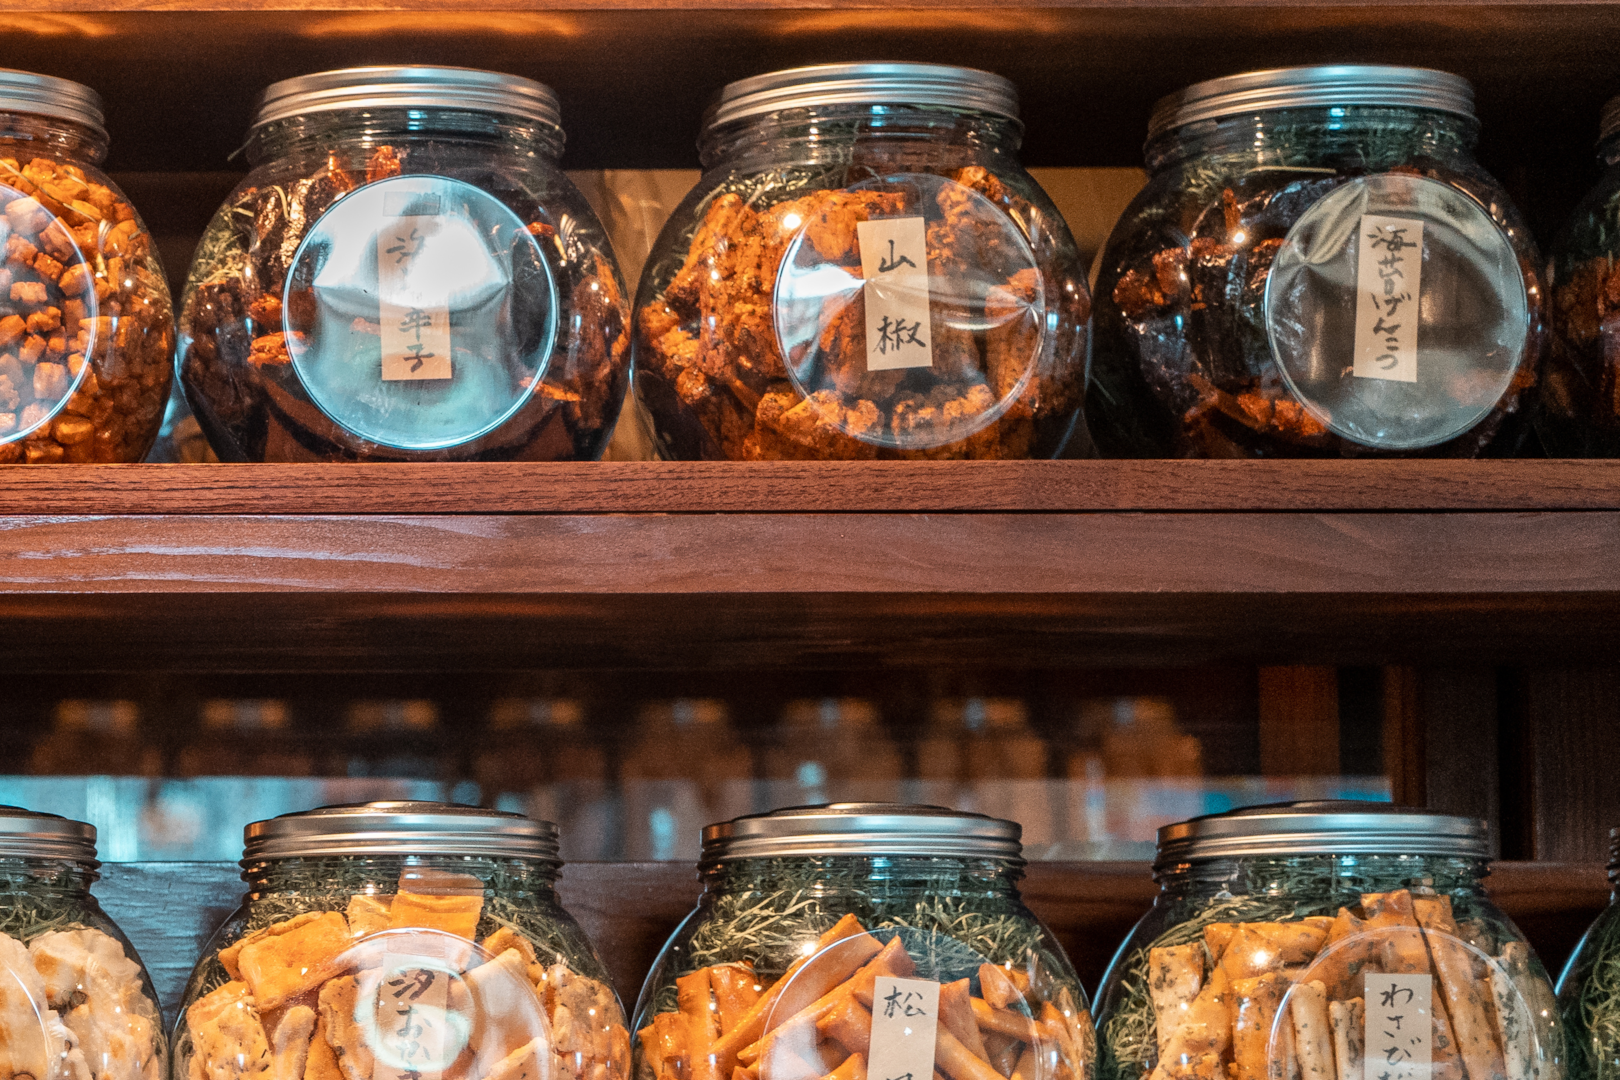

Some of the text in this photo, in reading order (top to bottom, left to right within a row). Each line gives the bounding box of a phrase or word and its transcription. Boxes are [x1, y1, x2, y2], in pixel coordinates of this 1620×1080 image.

[873, 239, 926, 354] 山椒
[1367, 226, 1417, 370] 海苔げんこつ
